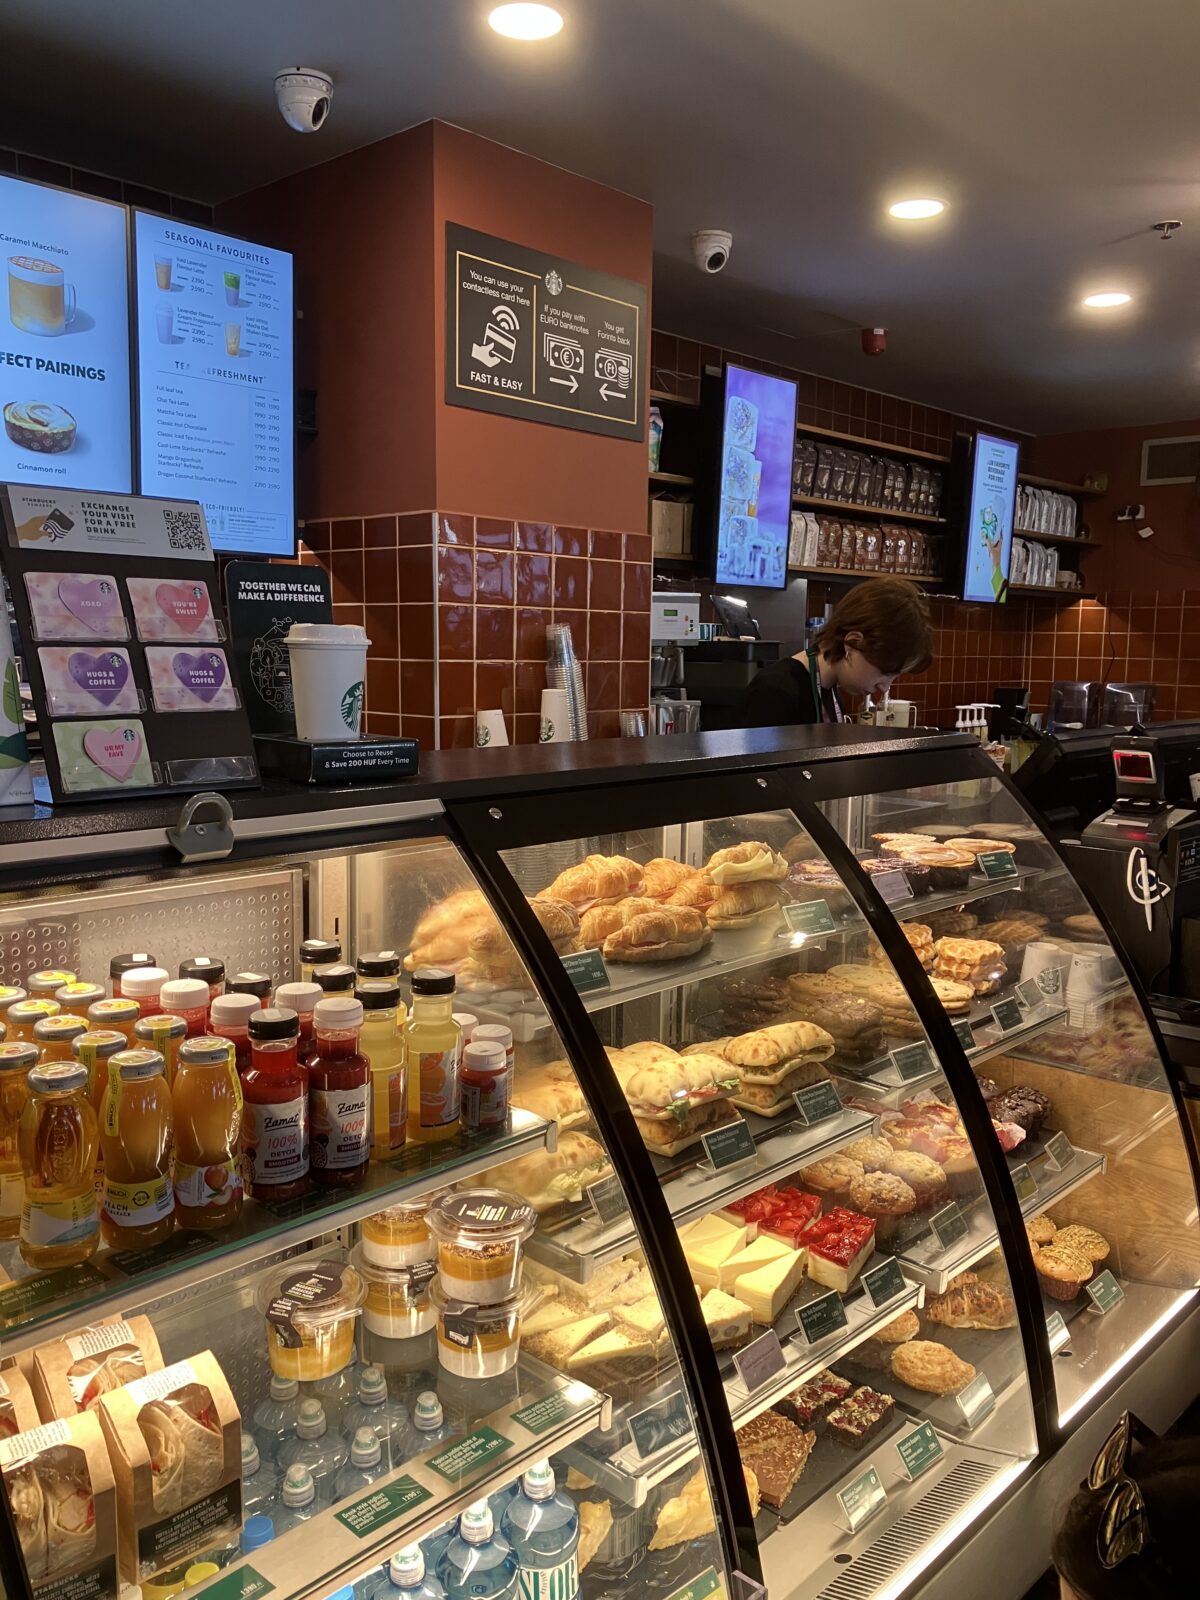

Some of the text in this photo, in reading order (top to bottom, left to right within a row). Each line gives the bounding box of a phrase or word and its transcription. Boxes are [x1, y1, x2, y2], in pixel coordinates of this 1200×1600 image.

[0, 233, 69, 256] Caramel Macchiato
[165, 230, 270, 265] SEASONAL FAVOURITES
[469, 270, 524, 293] You can use your
[462, 281, 531, 306] contactless card here
[549, 306, 561, 318] you
[561, 309, 573, 323] pay
[573, 312, 586, 323] with
[540, 314, 590, 335] EURO banknotes
[604, 320, 625, 334] You get
[597, 330, 630, 346] Forints back
[36, 356, 106, 381] PAIRINGS
[470, 371, 523, 391] FAST & EASY
[17, 463, 67, 475] Cinnamon roll
[81, 501, 130, 513] EXCHANGE
[82, 509, 135, 521] YOUR VISIT
[84, 518, 105, 526] FOR
[115, 520, 137, 529] FREE
[86, 526, 117, 535] DRINK
[240, 581, 321, 593] TOGETHER WE CAN
[238, 592, 325, 603] MAKE A DIFFERENCE
[342, 750, 367, 758] Choose
[375, 749, 394, 757] Reuse
[324, 761, 330, 769] &
[331, 760, 348, 768] Save
[348, 759, 363, 767] 200
[363, 758, 377, 766] HUF
[377, 758, 394, 767] Every
[338, 1099, 367, 1115] Zama
[264, 1113, 300, 1129] Zamat
[268, 1135, 298, 1149] 100%
[270, 1148, 296, 1158] DETOX
